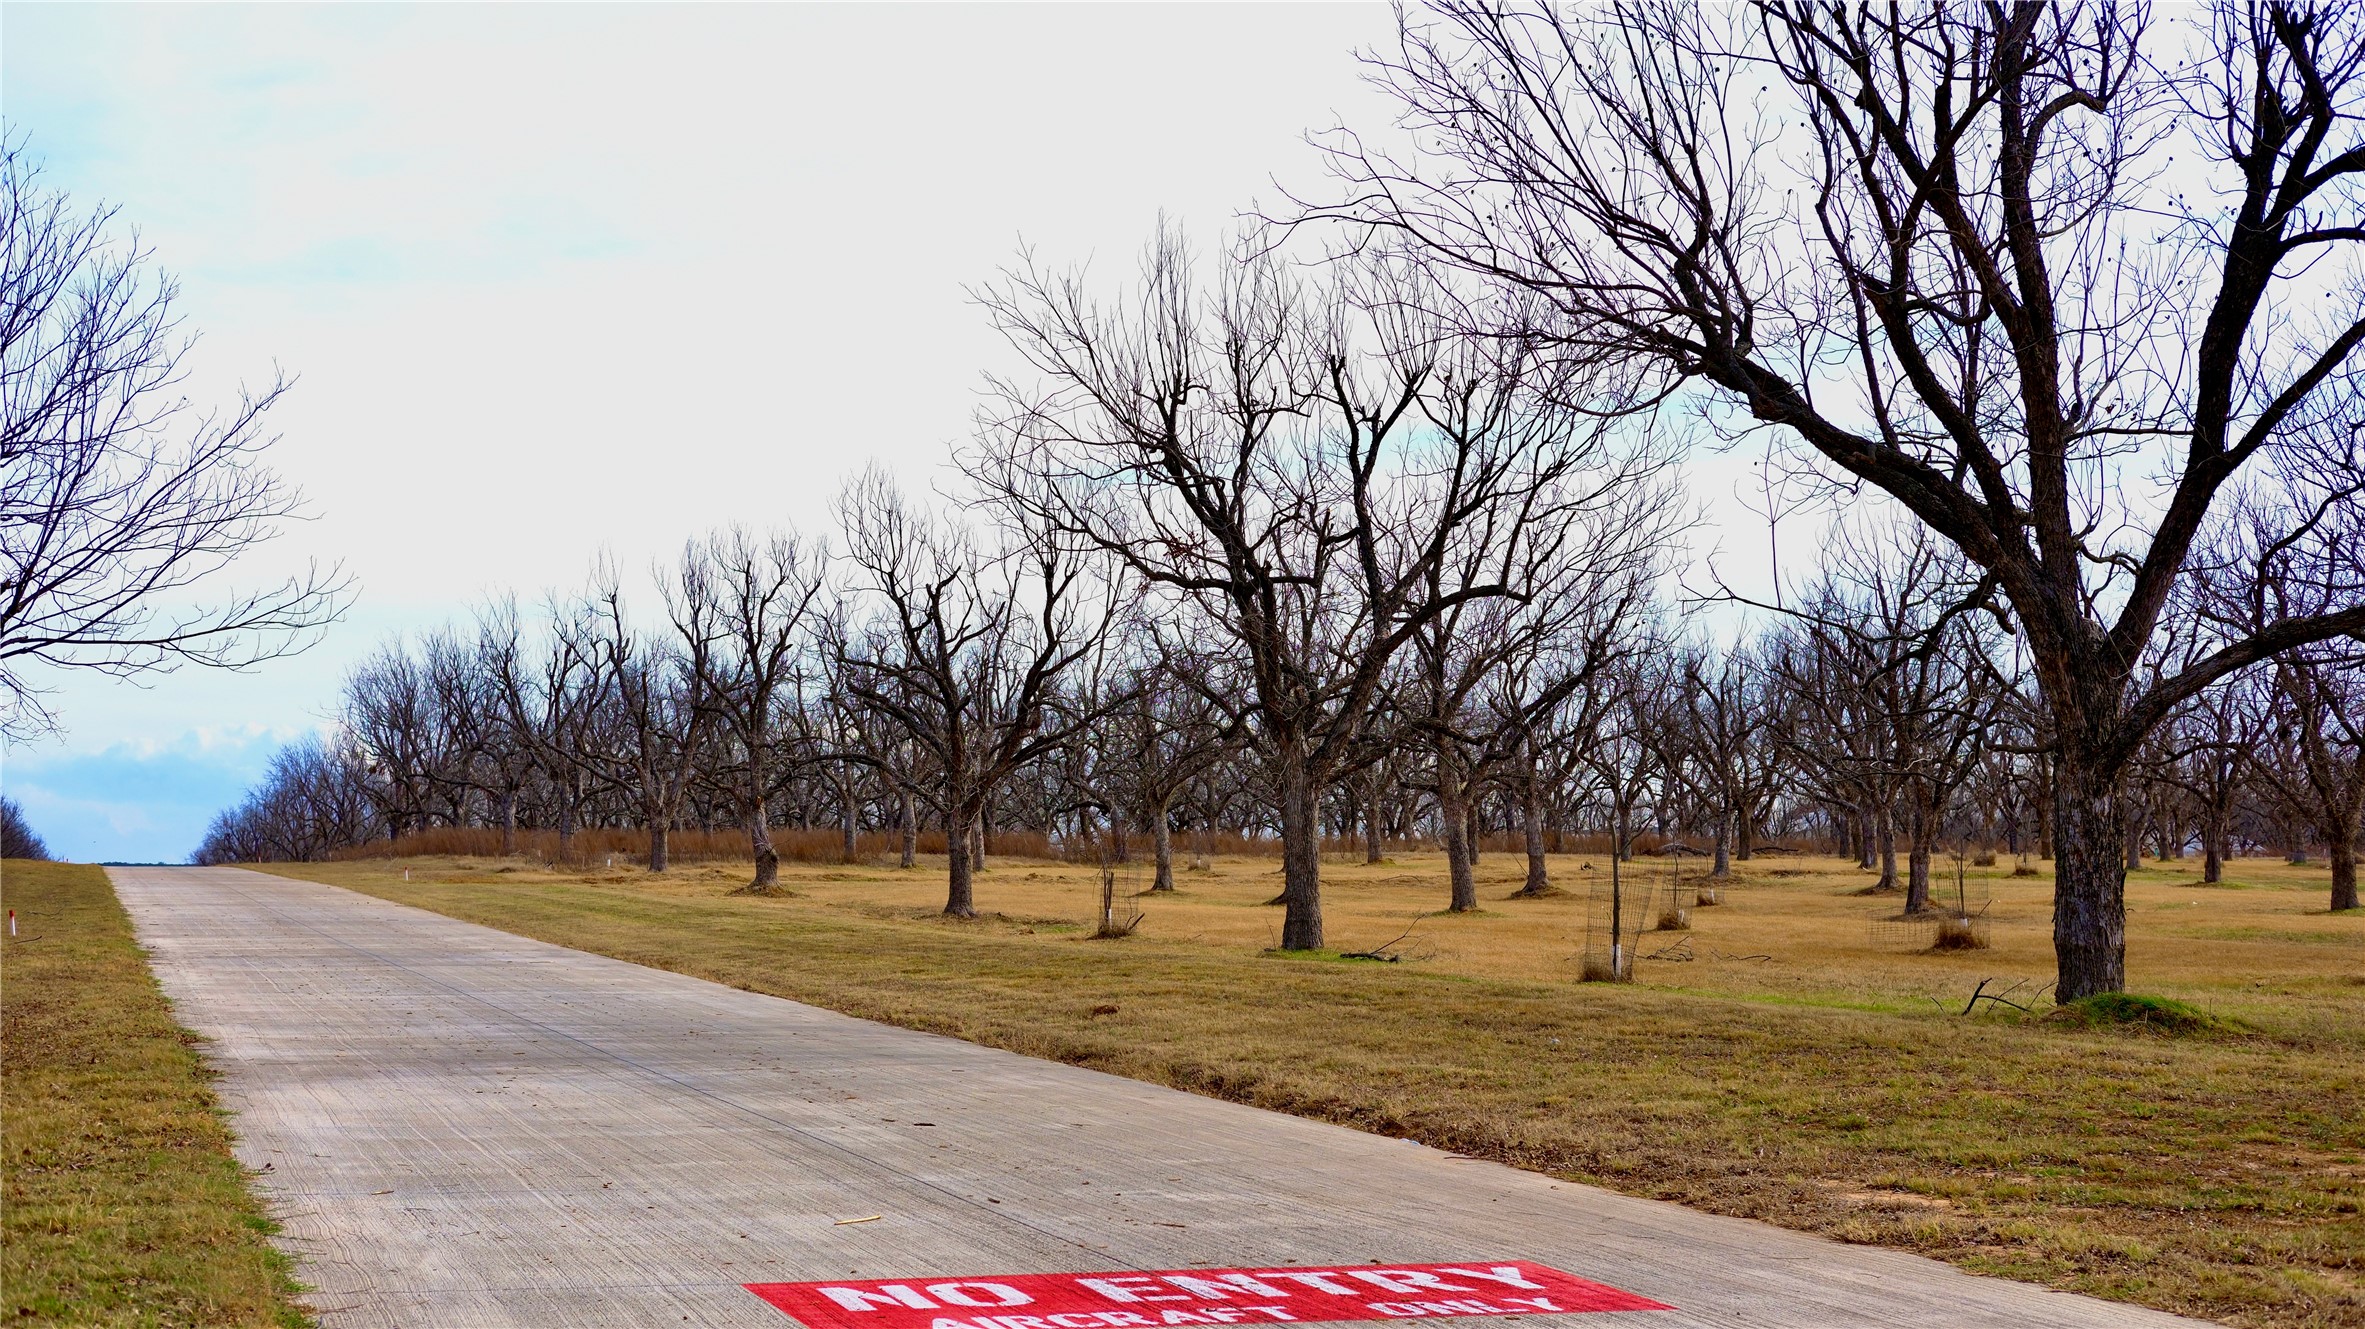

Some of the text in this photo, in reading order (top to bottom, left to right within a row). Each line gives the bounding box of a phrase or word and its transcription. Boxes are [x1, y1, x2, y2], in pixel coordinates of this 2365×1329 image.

[817, 1266, 1546, 1311] NO ENTRY
[931, 1298, 1563, 1329] AIRCRAFT ONLY
